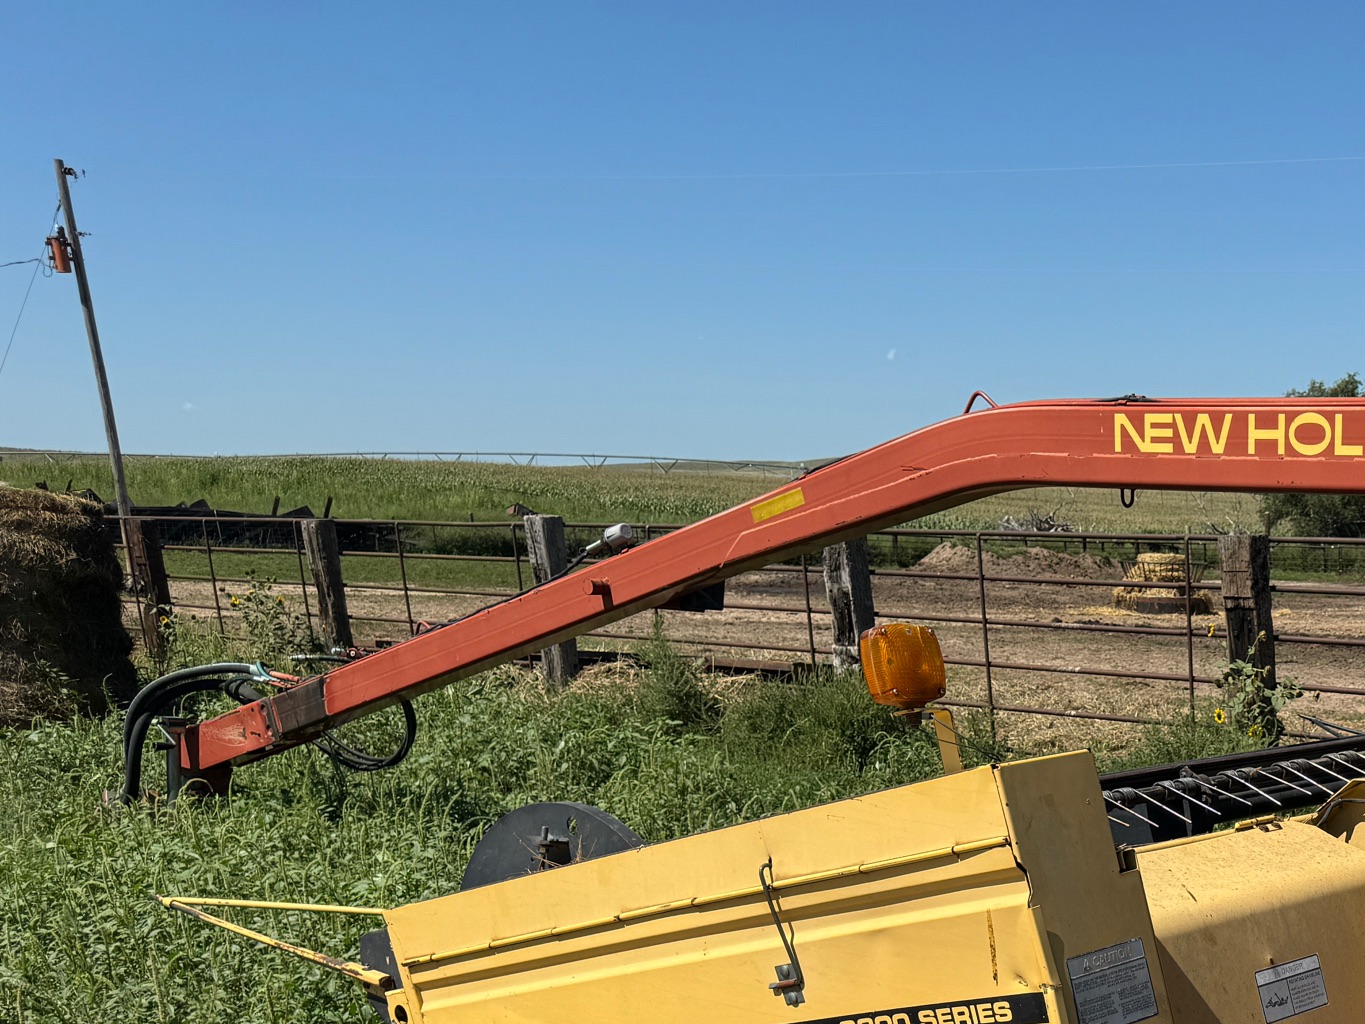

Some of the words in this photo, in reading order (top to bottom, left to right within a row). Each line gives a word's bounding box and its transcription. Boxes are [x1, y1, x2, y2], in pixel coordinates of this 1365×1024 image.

[1113, 413, 1233, 454] NEW
[1092, 946, 1132, 966] CAUTION
[1281, 962, 1304, 975] DANGER
